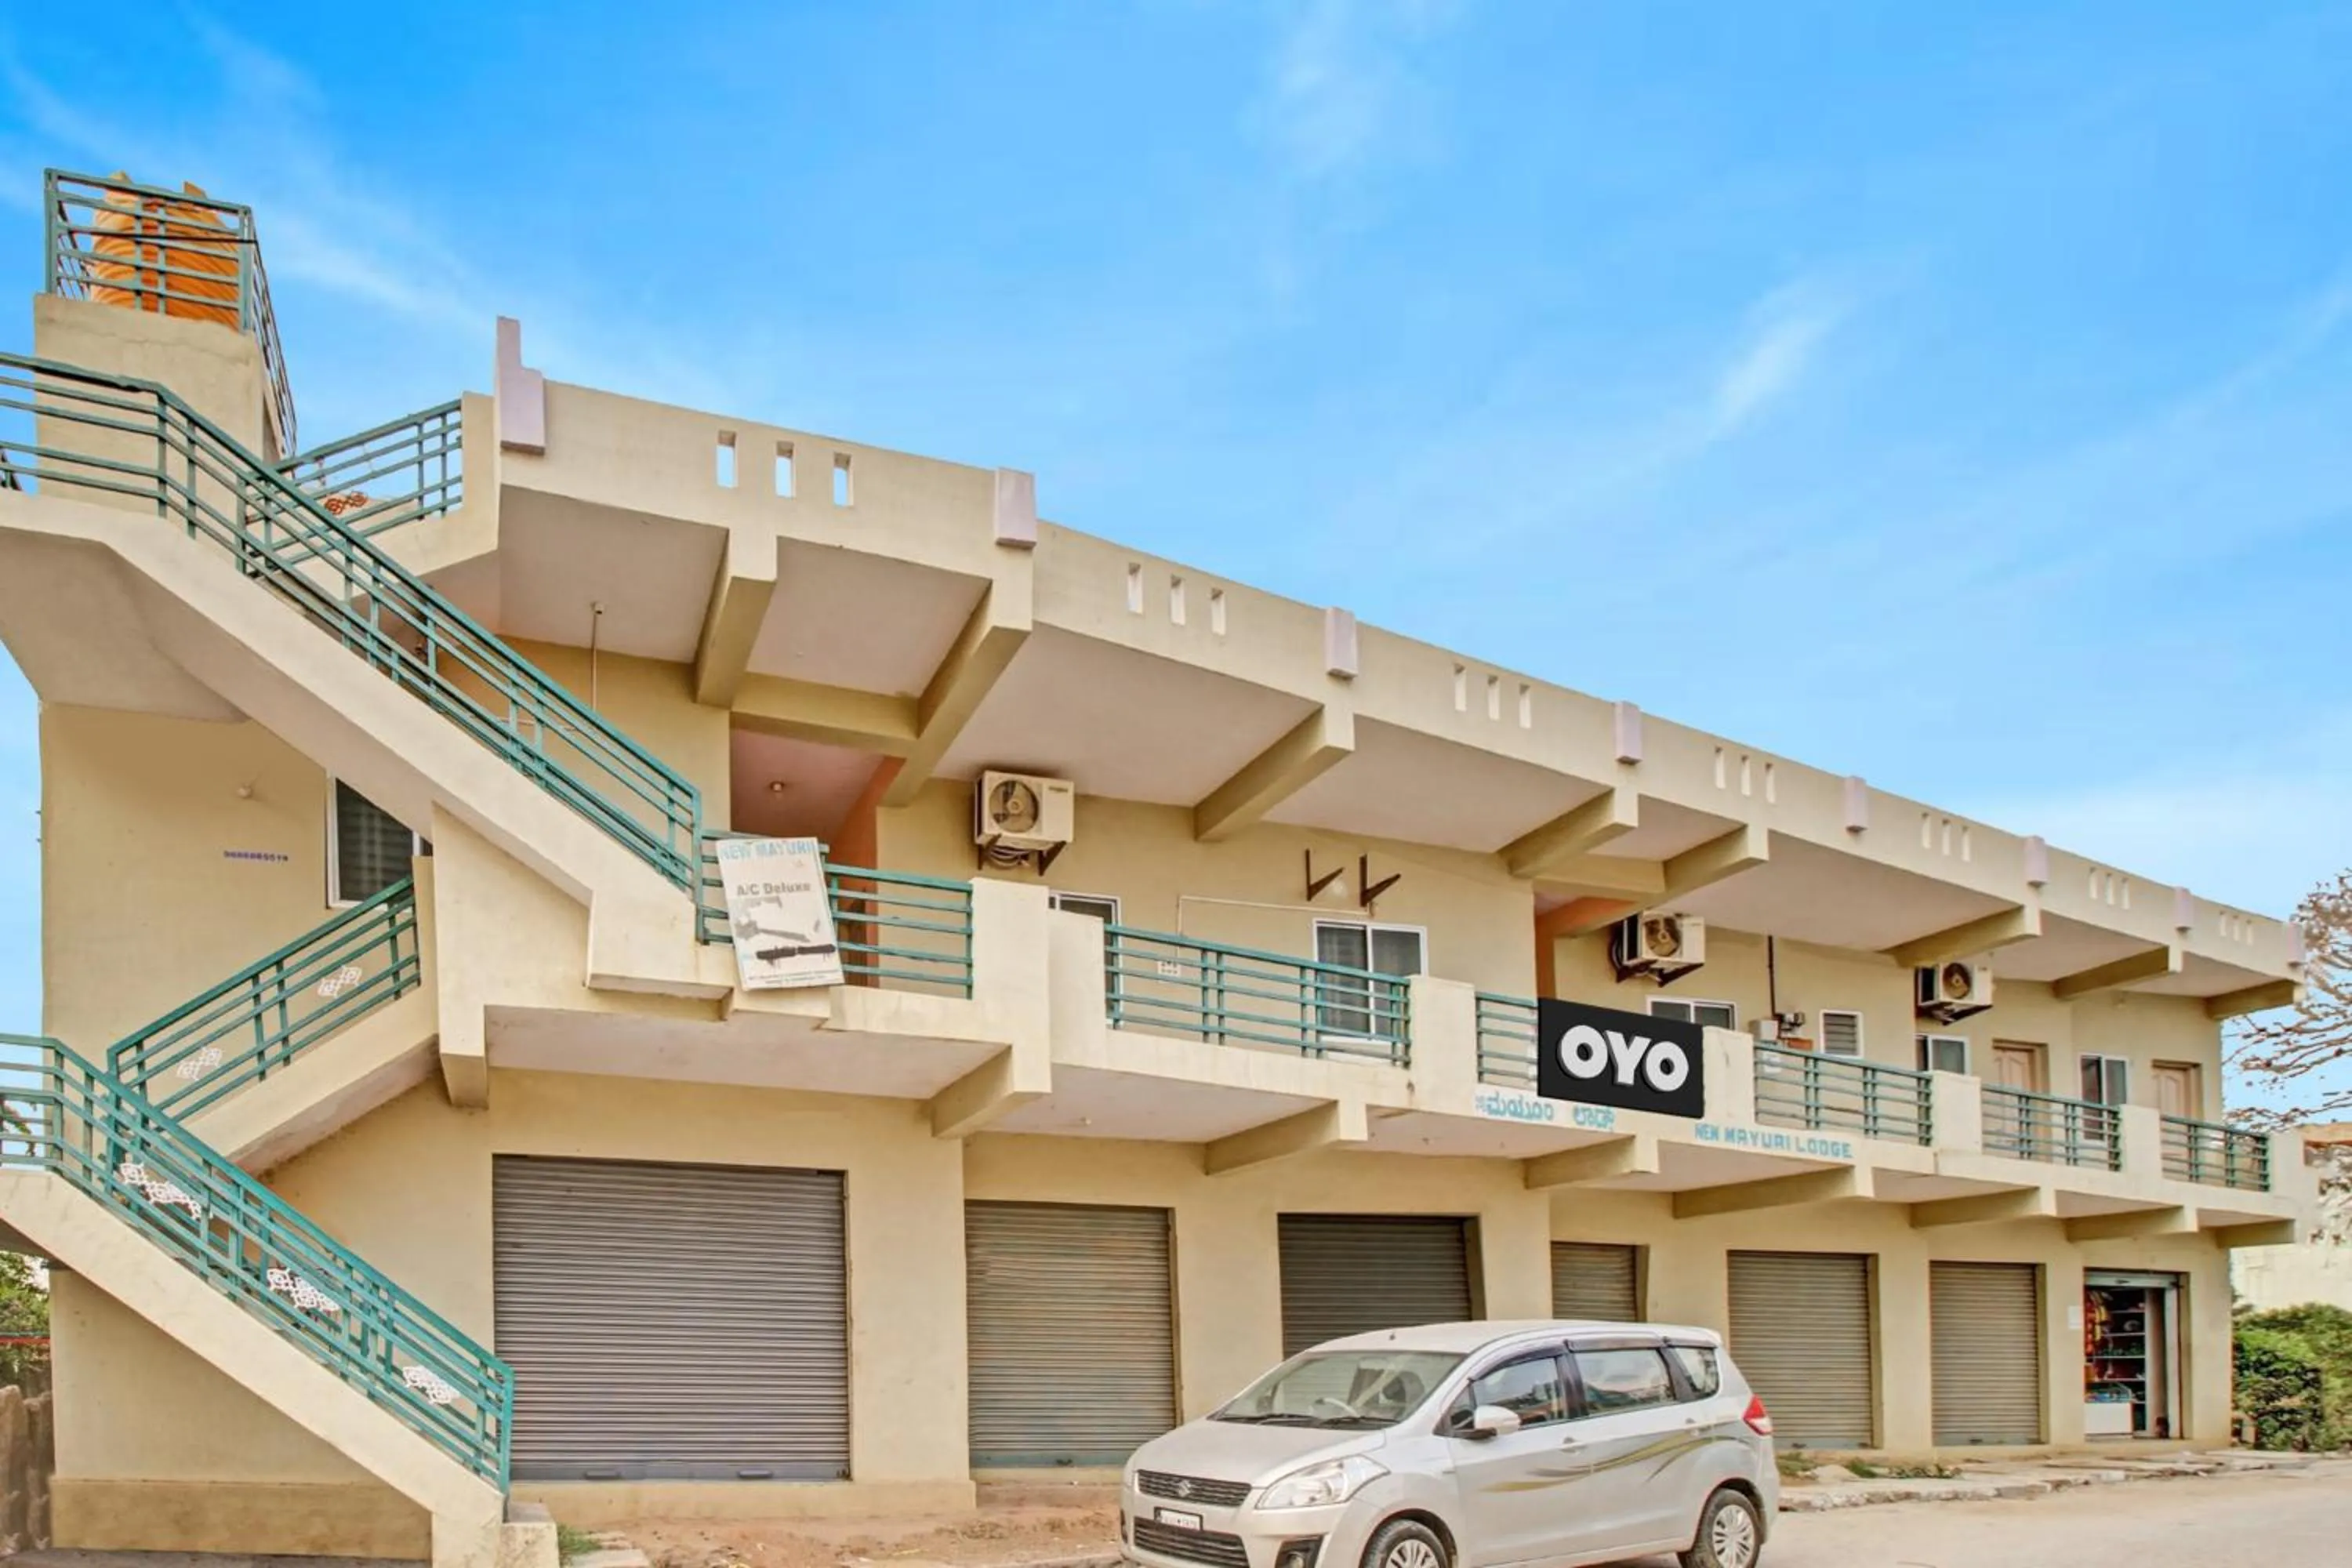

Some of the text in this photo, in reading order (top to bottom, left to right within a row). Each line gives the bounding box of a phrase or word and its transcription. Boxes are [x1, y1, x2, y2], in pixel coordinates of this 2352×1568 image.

[763, 881, 811, 895] Deluxe
[1558, 1024, 1689, 1092] OYO
[1695, 1123, 1854, 1159] NEW MAYURI LODGE
